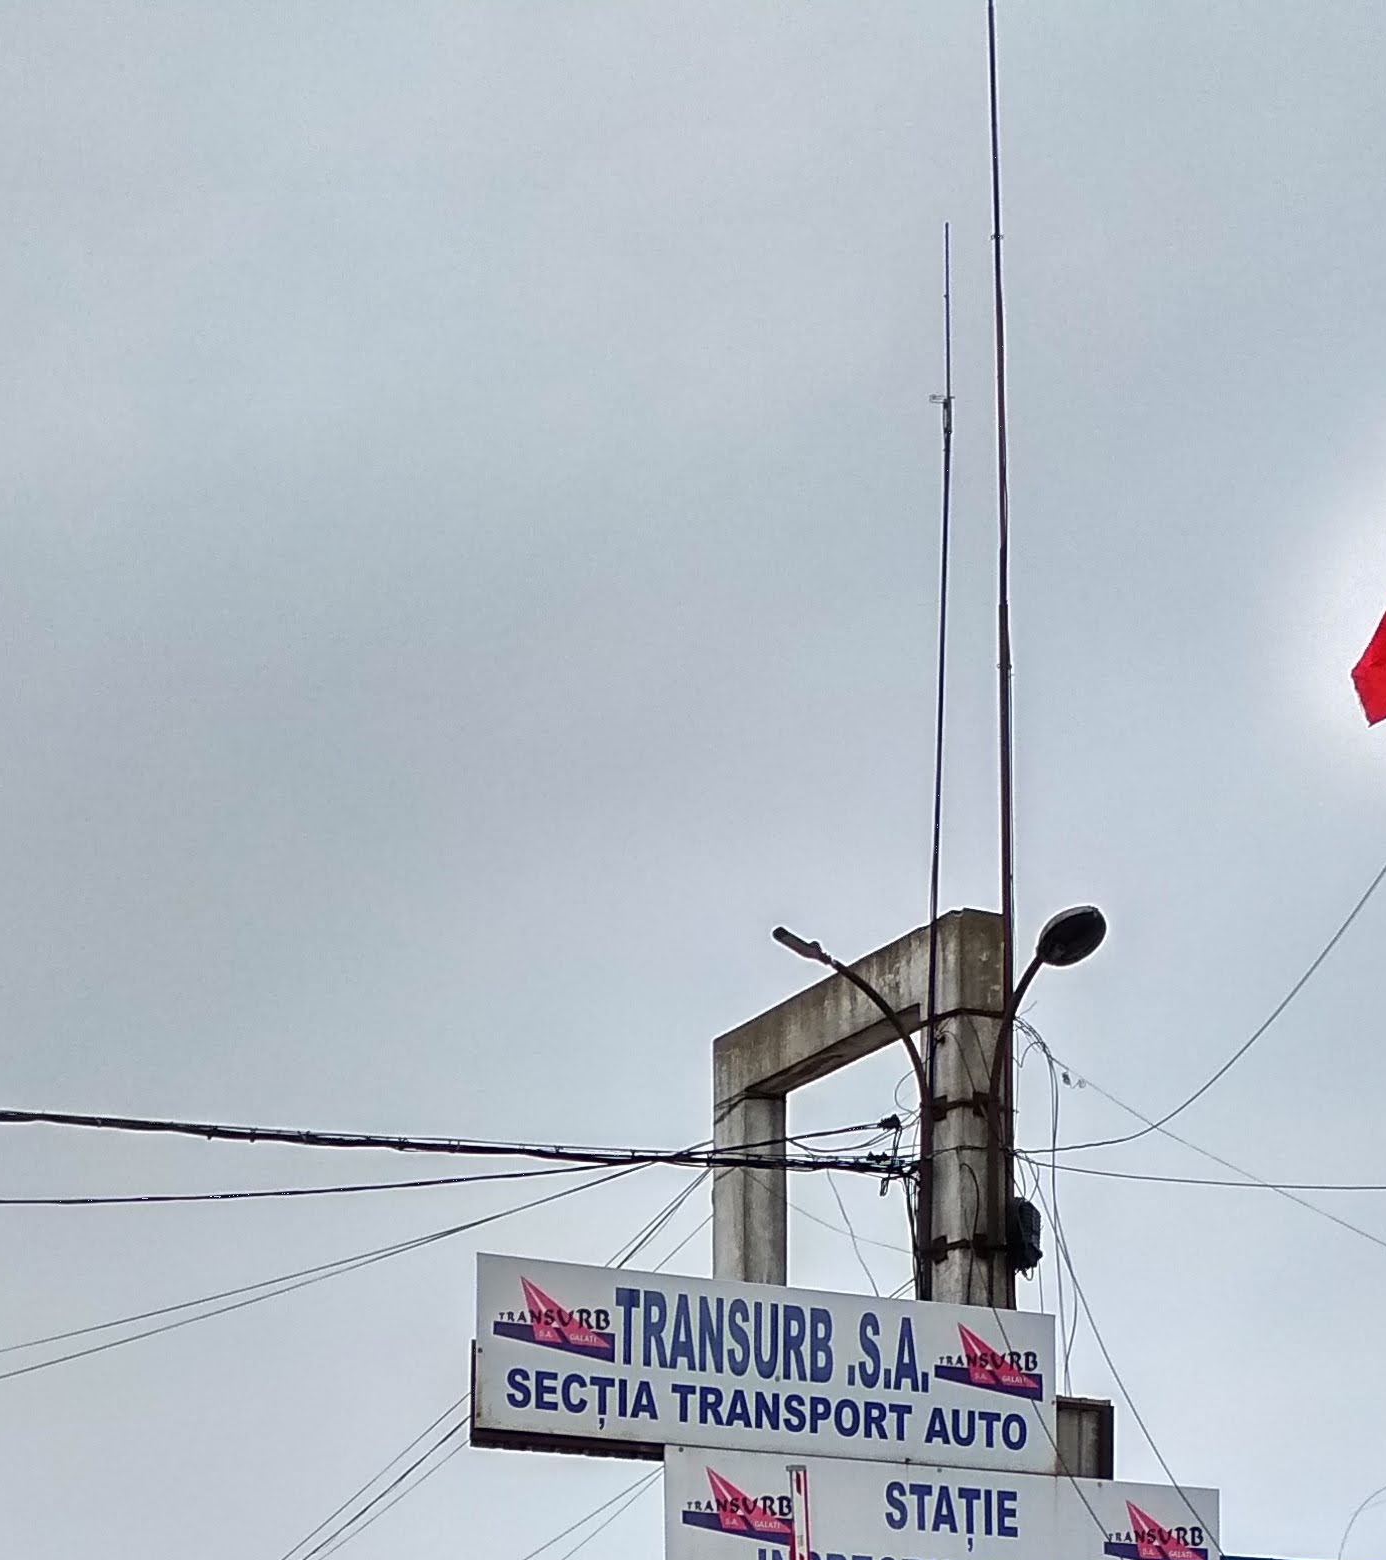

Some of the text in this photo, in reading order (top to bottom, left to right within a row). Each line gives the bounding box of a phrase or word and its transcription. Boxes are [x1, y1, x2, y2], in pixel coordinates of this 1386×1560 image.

[498, 1308, 611, 1331] TRANSURB
[615, 1287, 834, 1383] TRANSURB
[938, 1351, 1038, 1372] TRANSURB
[506, 1367, 1028, 1451] SECȚIA TRANSPORT AUTO
[687, 1495, 793, 1517] TRANSURB
[885, 1481, 1019, 1552] STAȚIE
[1108, 1526, 1204, 1547] TRANSURB
